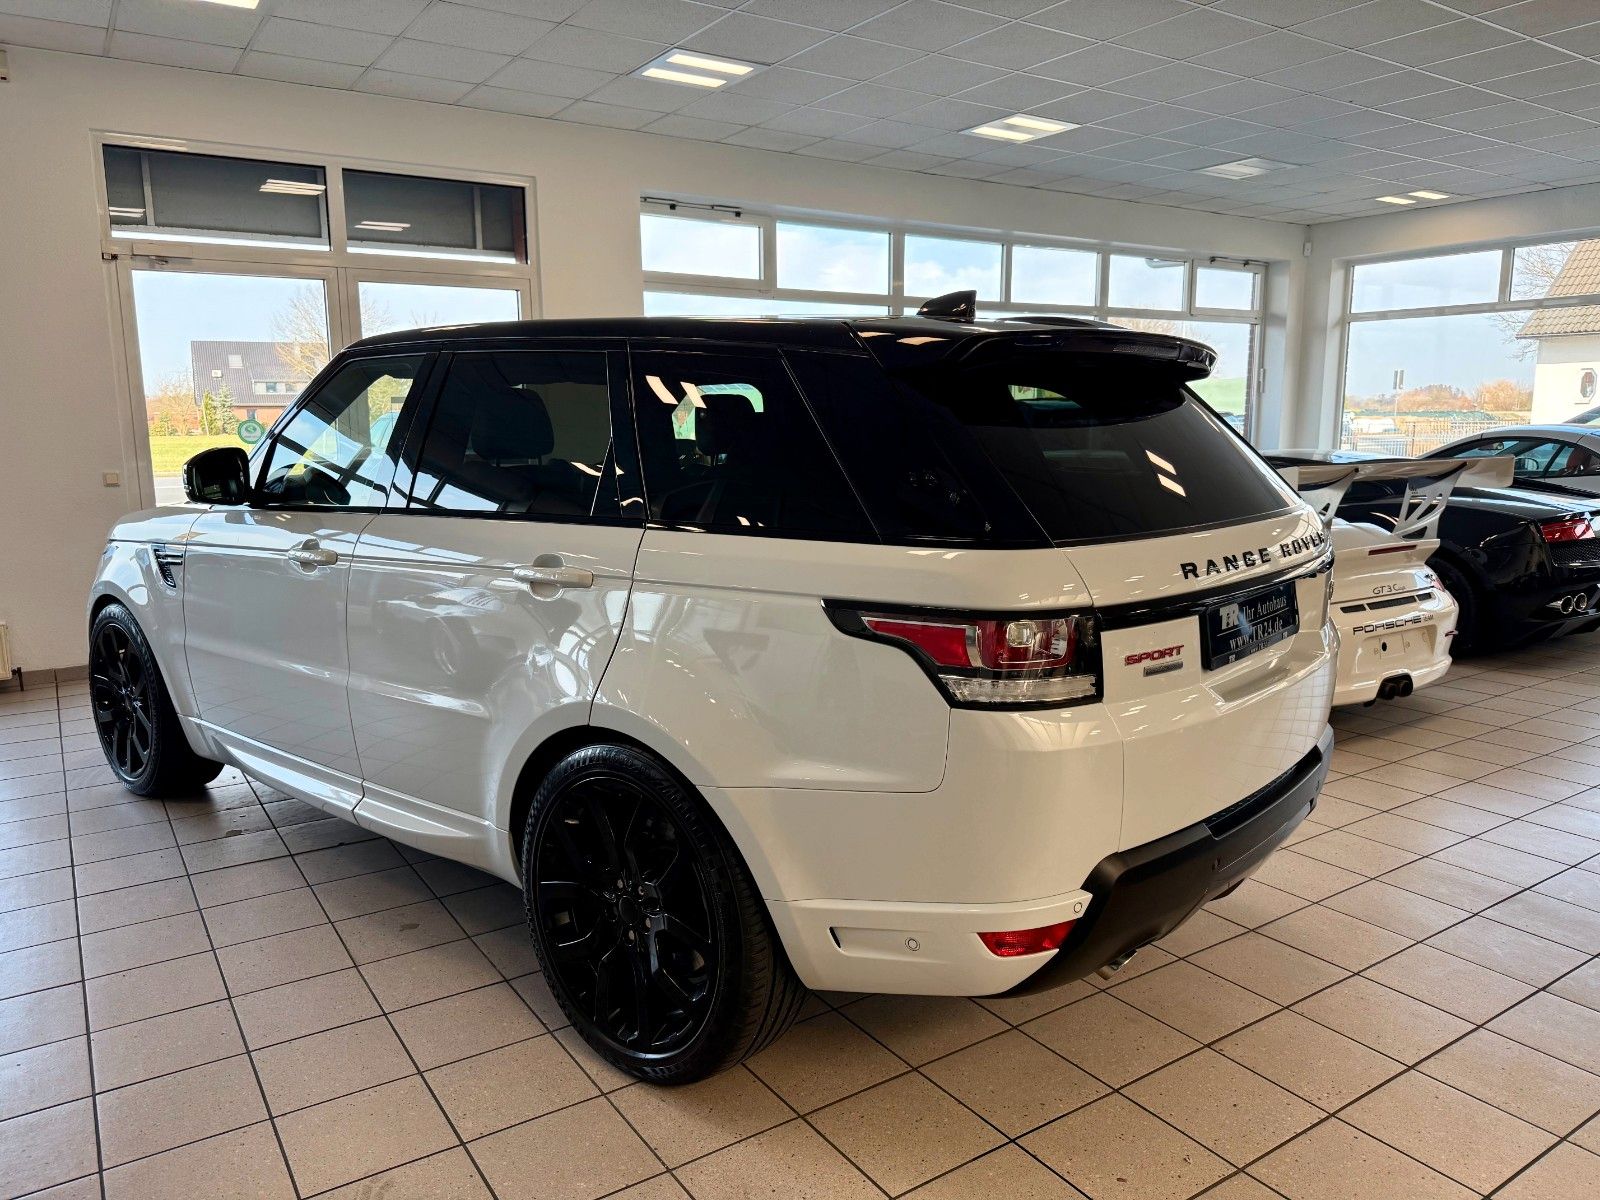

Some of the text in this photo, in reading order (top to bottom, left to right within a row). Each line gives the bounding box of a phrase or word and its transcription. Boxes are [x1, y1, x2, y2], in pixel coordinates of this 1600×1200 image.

[1180, 531, 1325, 580] RANGE ROVER
[1242, 595, 1287, 621] Ihr Autohaus
[1229, 616, 1283, 651] www.TR24.de
[1352, 615, 1422, 635] PORSCHE
[1124, 644, 1185, 667] SPORT
